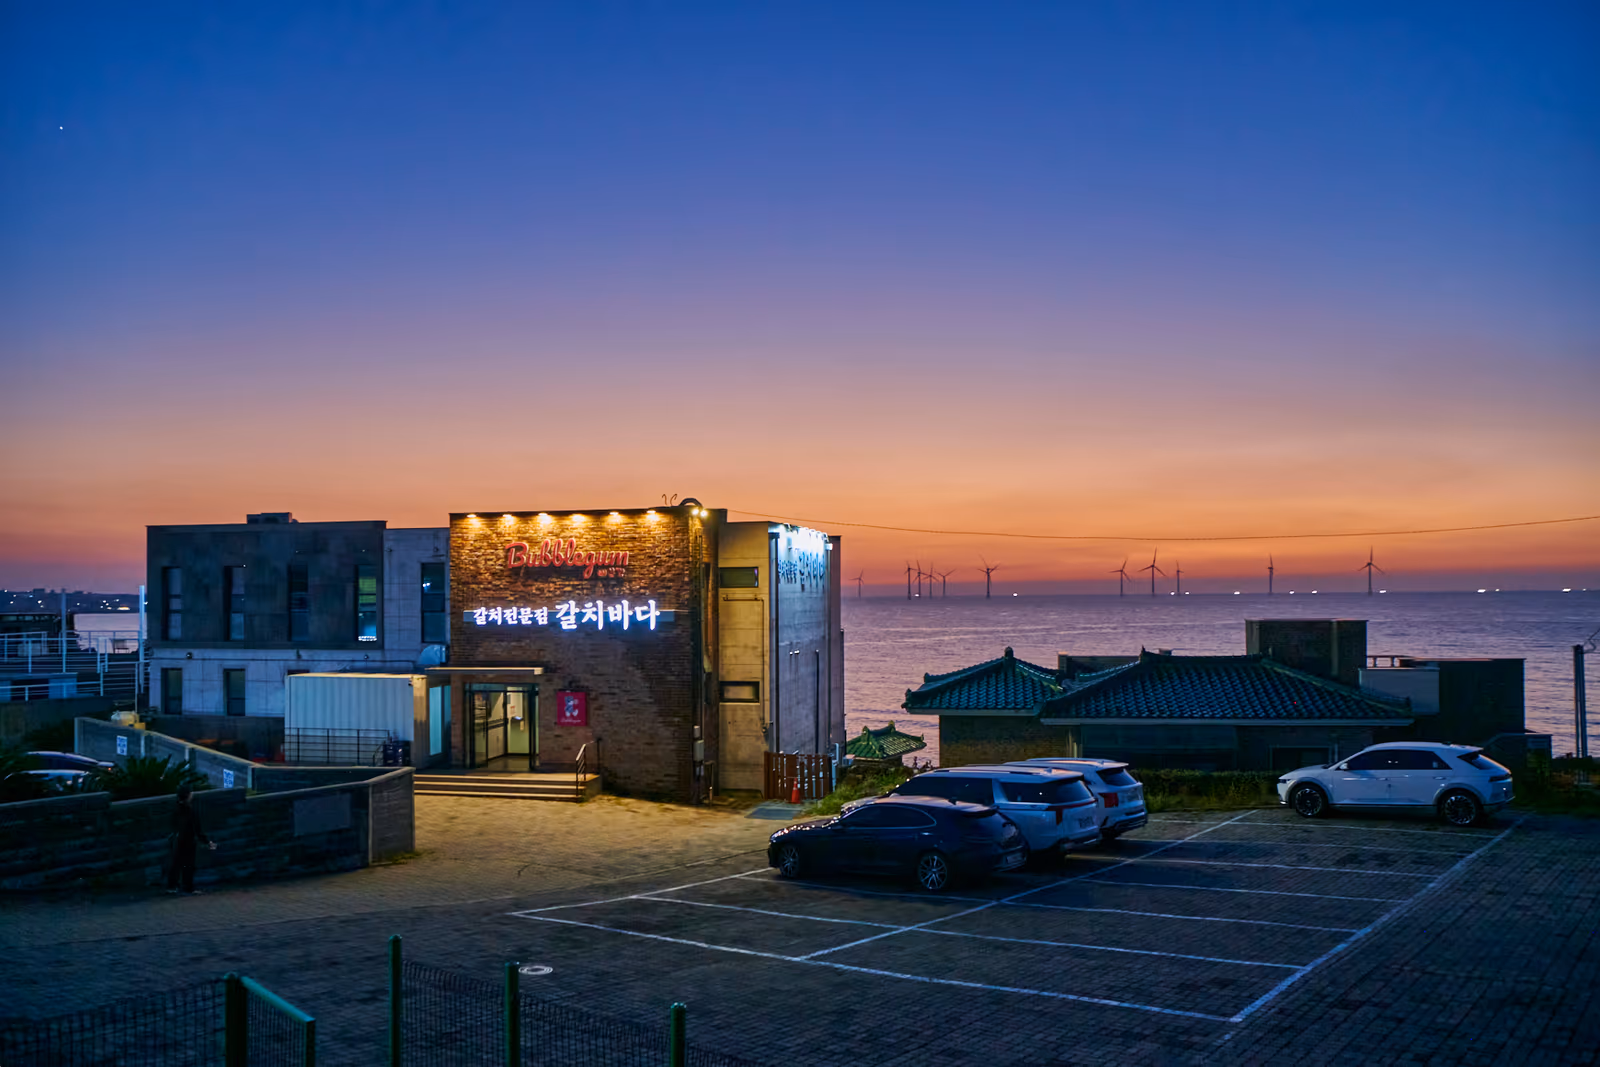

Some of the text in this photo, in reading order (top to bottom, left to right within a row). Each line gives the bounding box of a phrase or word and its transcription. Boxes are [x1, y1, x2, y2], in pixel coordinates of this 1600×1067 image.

[505, 538, 630, 579] Bubblegum
[473, 599, 661, 631] 갈치전문점 갈치바다
